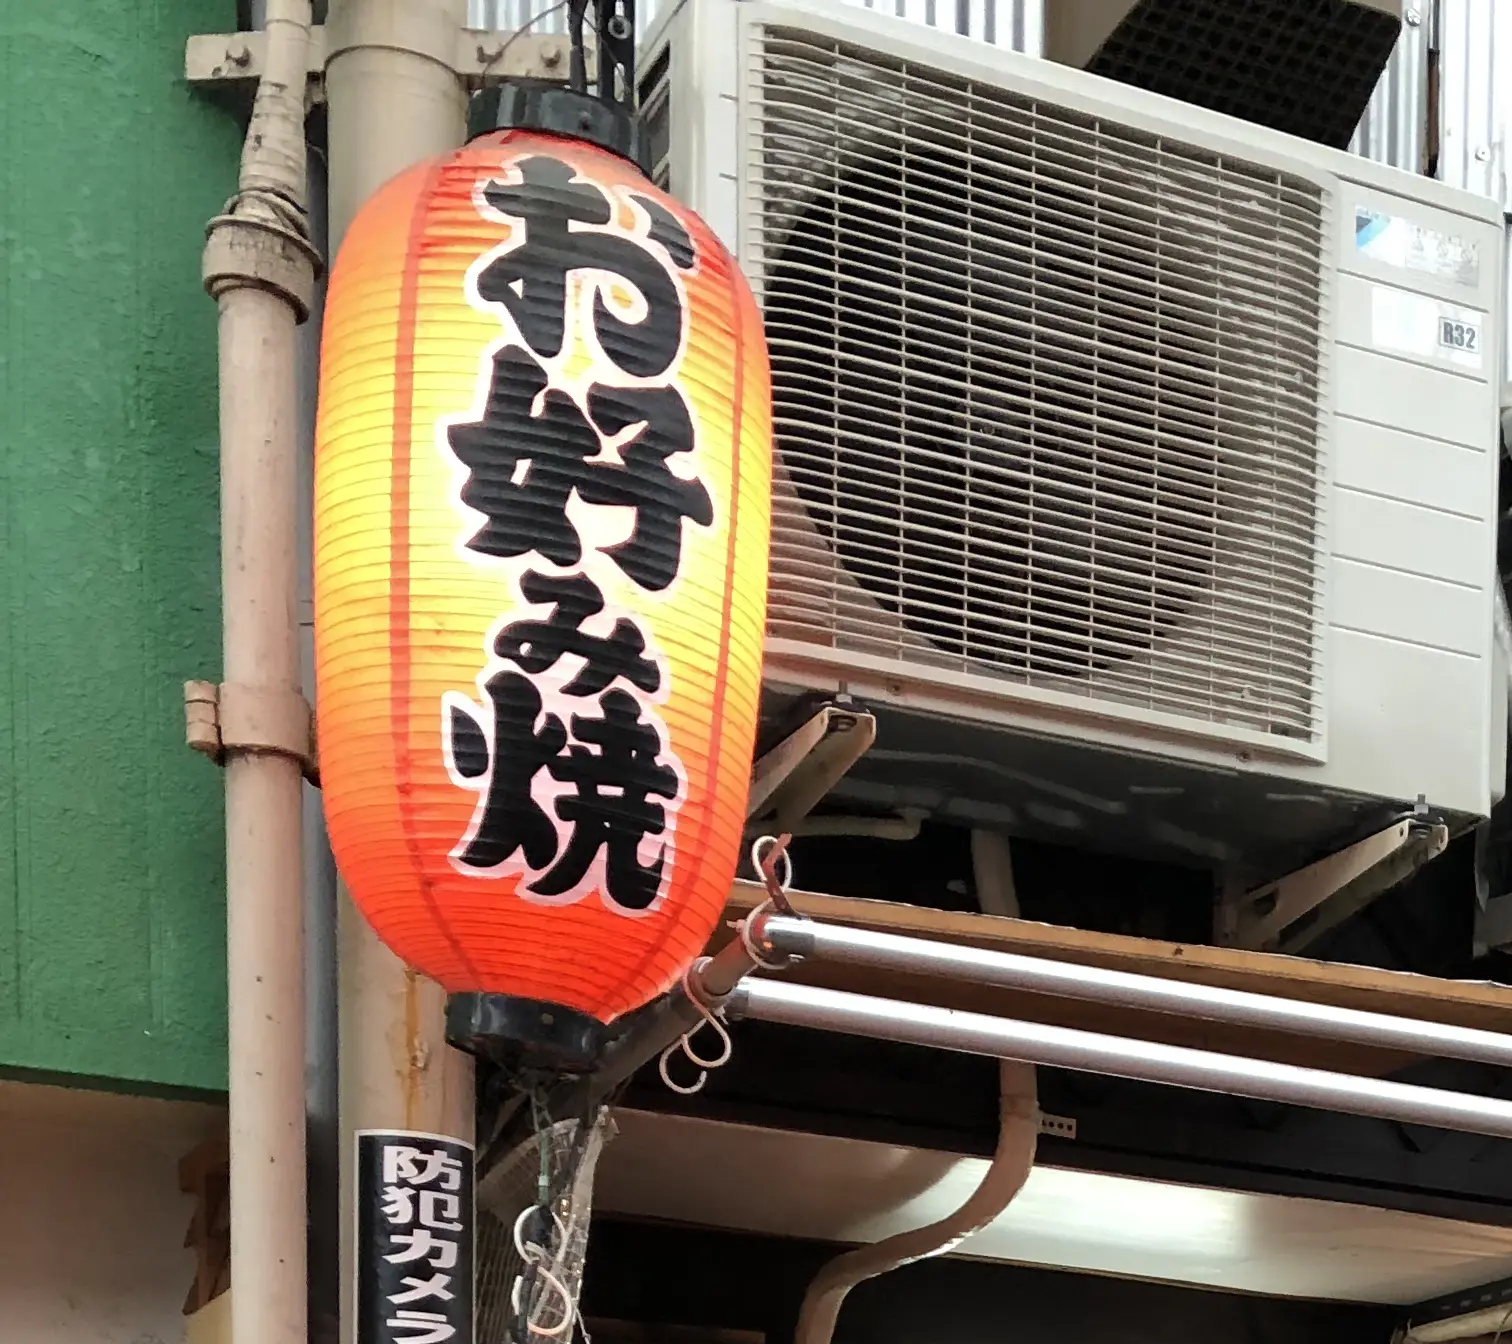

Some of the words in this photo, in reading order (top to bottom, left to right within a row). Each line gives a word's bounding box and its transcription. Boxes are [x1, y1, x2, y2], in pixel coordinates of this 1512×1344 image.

[1443, 321, 1476, 350] R32
[448, 156, 714, 910] お好み焼
